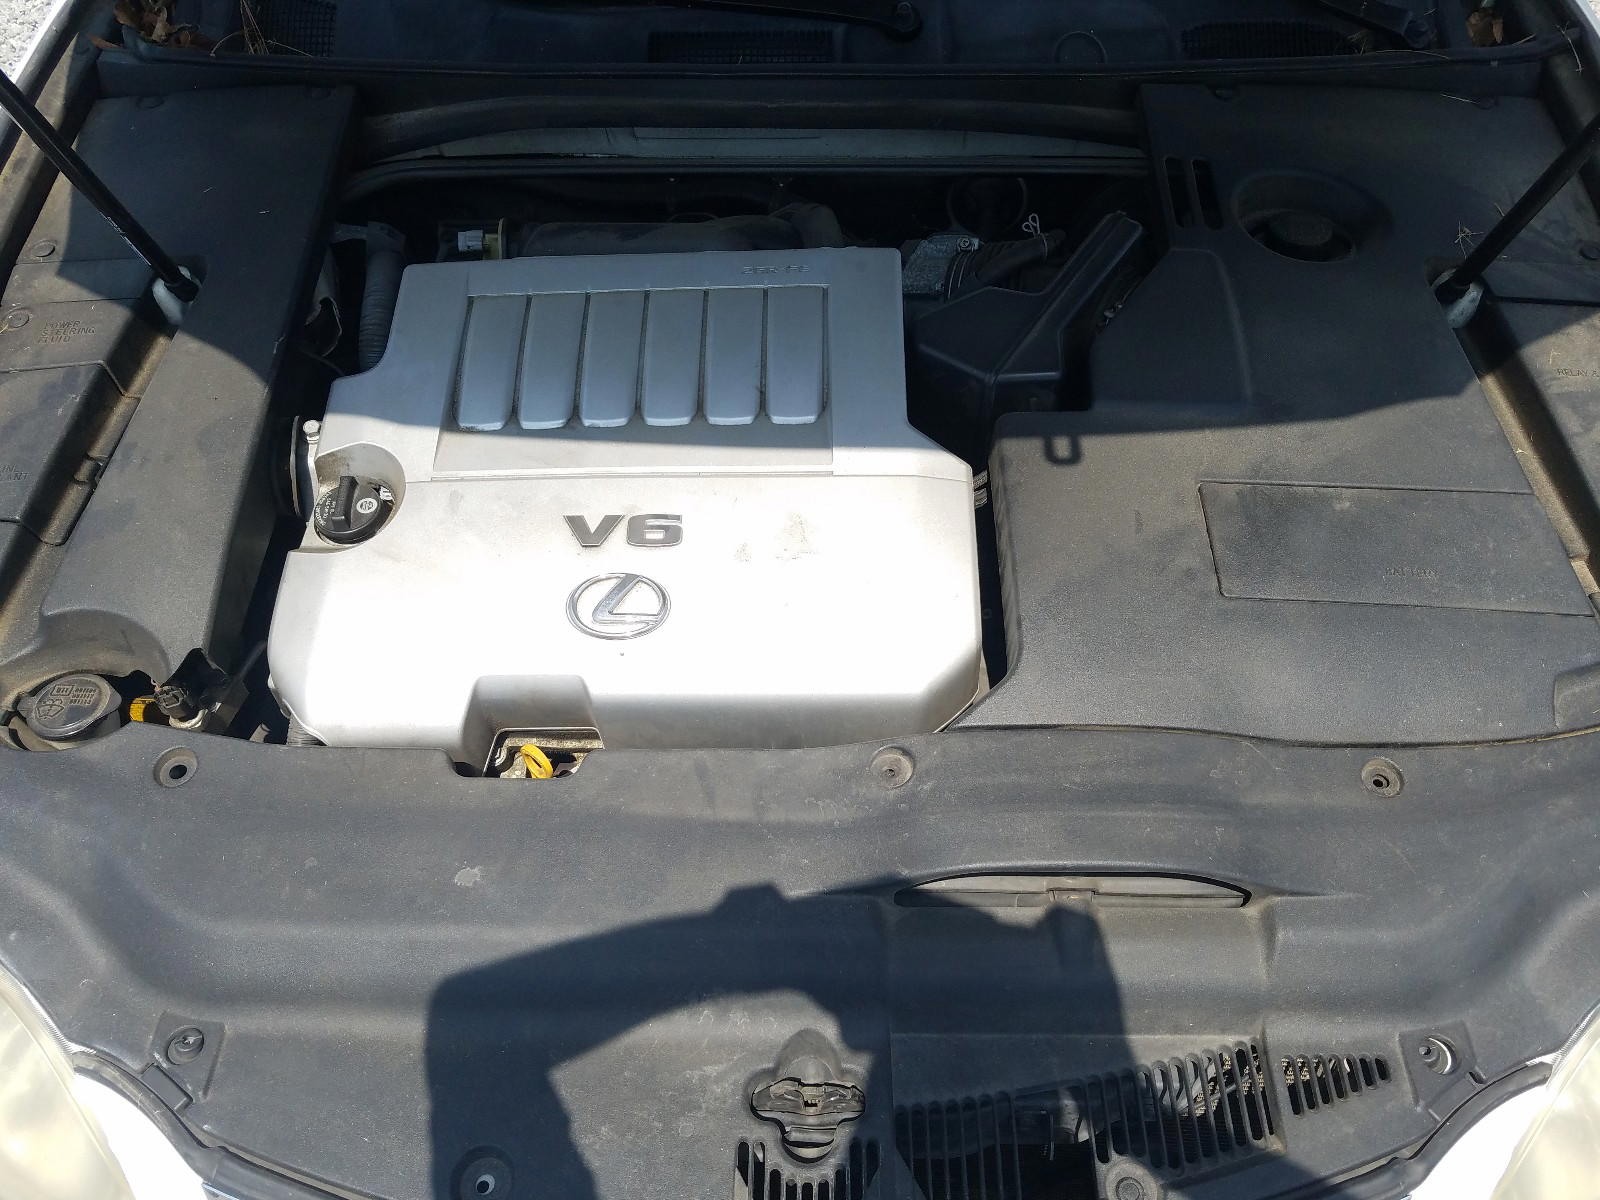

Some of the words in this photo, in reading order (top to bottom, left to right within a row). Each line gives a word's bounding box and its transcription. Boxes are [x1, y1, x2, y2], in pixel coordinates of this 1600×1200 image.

[44, 320, 81, 329] POWER
[40, 326, 96, 337] STEERING
[37, 335, 71, 344] FLUID
[563, 513, 684, 548] V6
